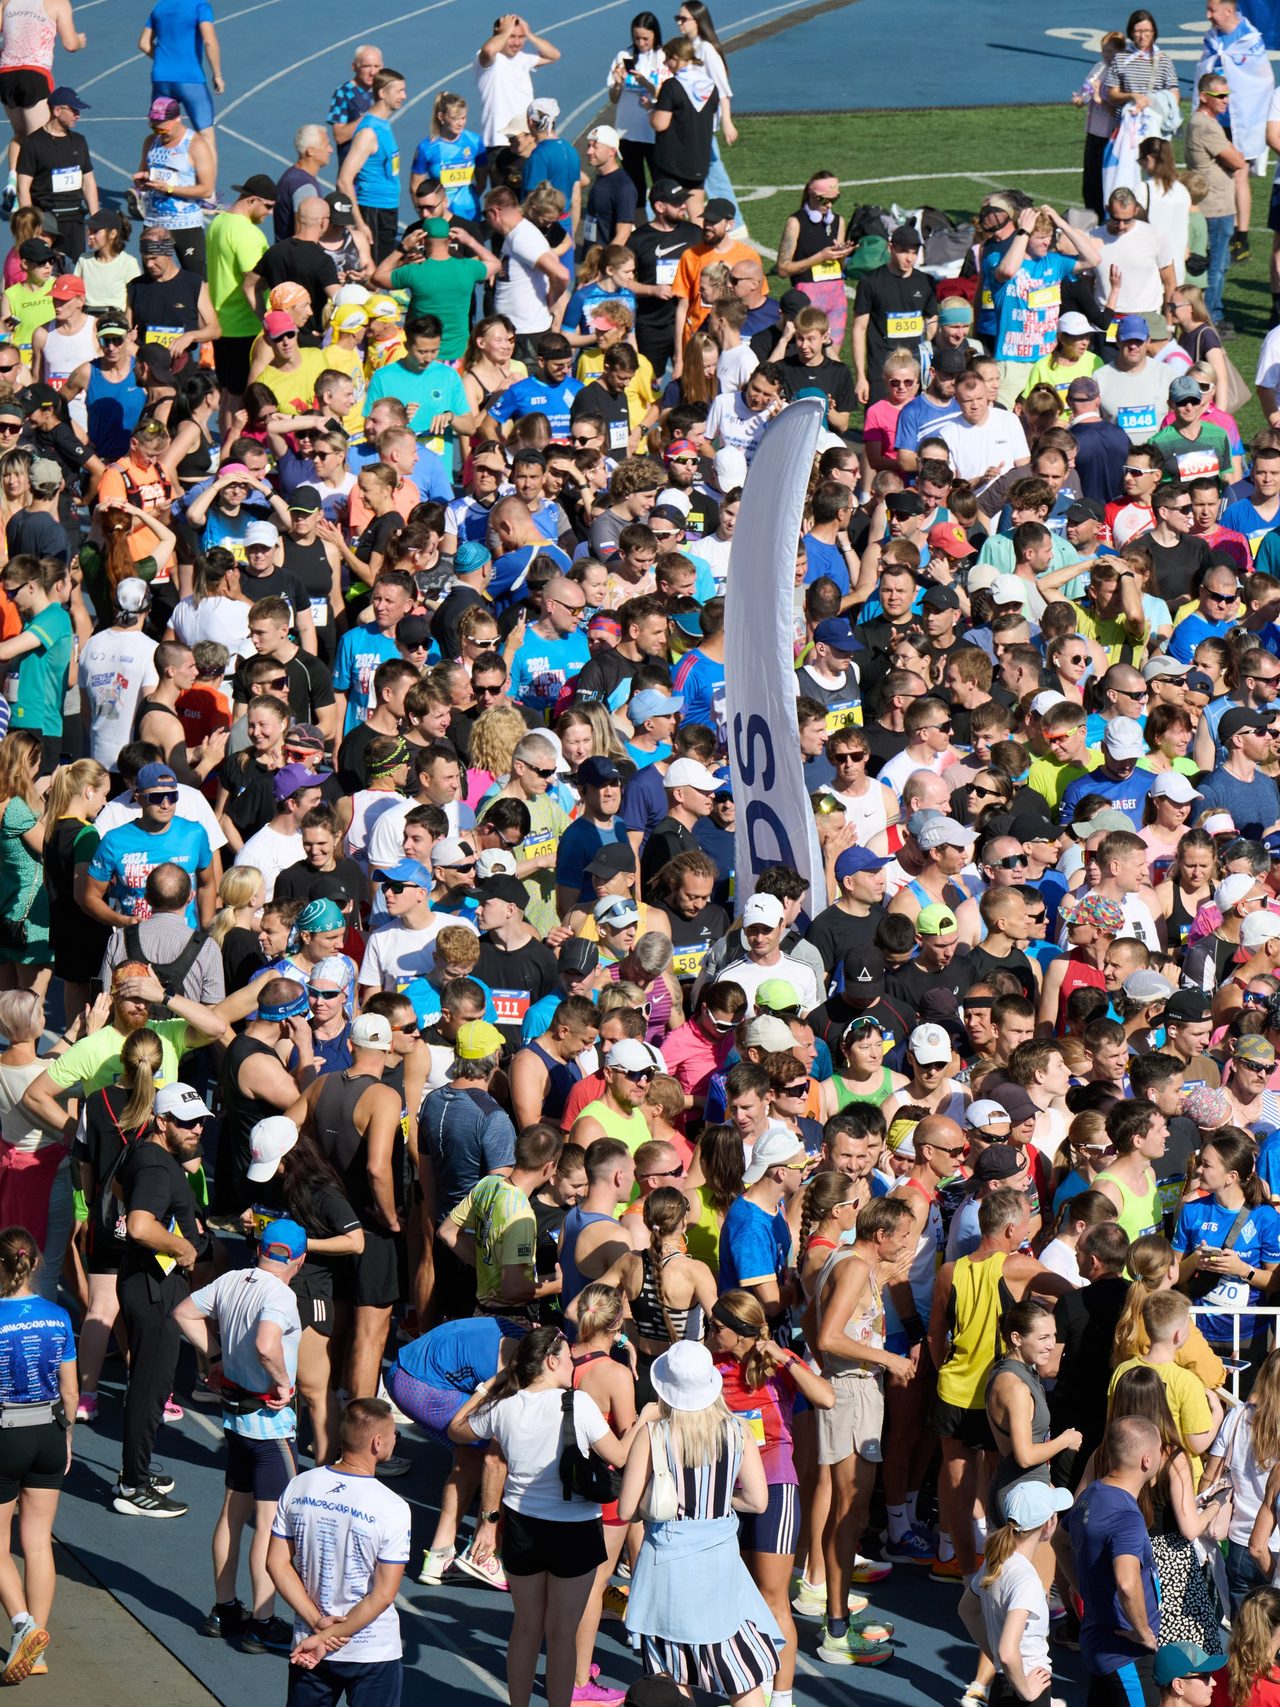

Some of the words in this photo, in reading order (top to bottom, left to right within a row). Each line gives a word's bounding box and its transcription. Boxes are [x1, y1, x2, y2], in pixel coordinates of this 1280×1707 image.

[64, 176, 75, 185] 71
[450, 171, 467, 182] 631
[896, 321, 917, 330] 830
[1122, 415, 1153, 427] 1848
[1184, 458, 1215, 475] 1099
[355, 654, 380, 667] 2024
[527, 657, 550, 672] 2024
[832, 711, 854, 727] 780
[121, 852, 148, 864] 2024
[1201, 1222, 1218, 1232] ВТБ
